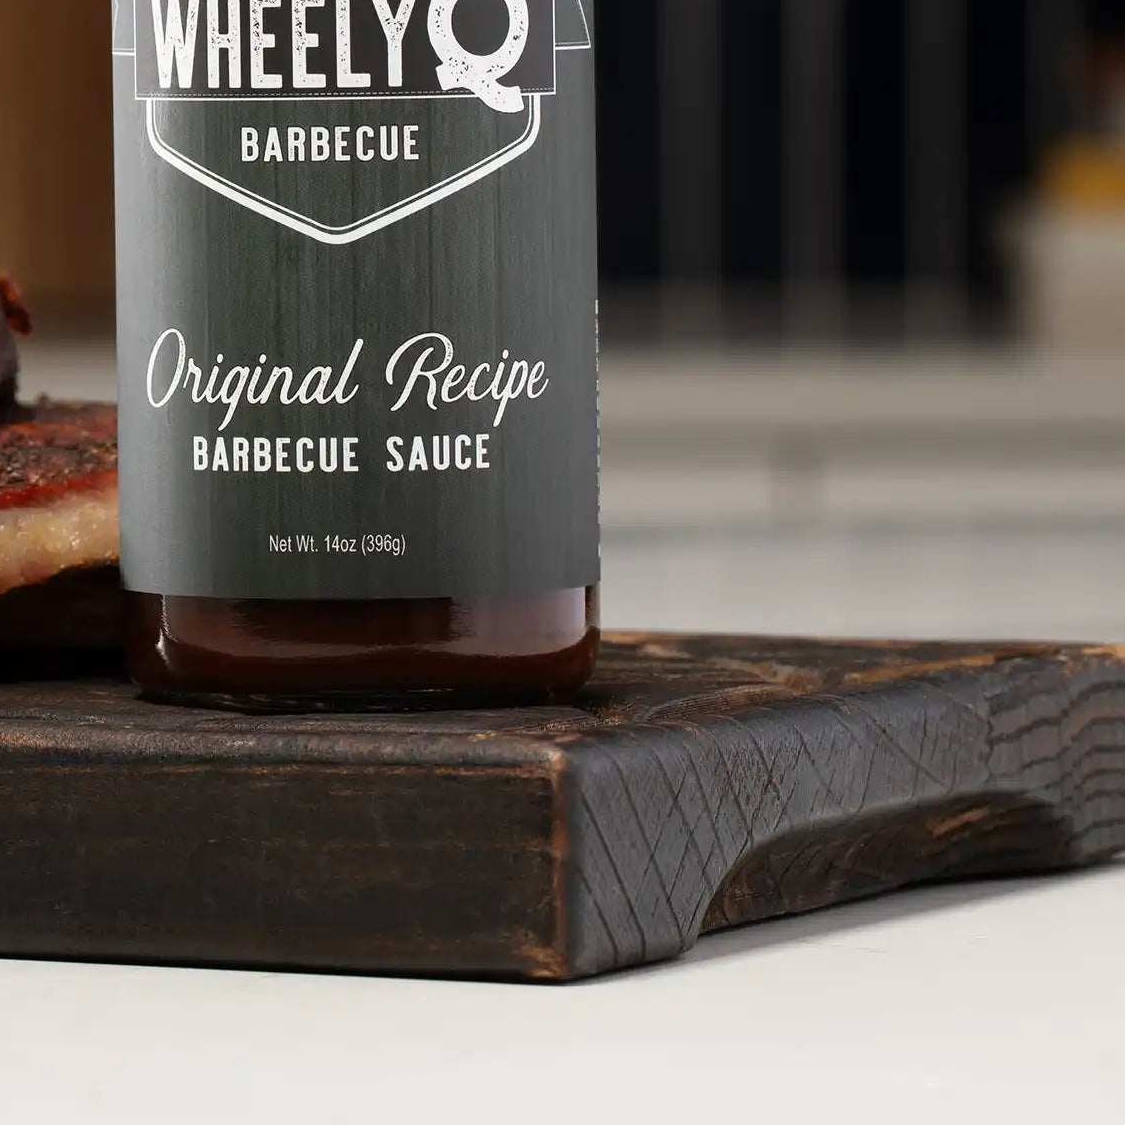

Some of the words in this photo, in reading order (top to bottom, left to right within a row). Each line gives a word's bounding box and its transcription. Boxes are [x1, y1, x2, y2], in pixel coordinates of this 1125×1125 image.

[241, 124, 420, 162] BARBECUE
[147, 328, 364, 432] Original
[386, 332, 549, 427] Recipe
[193, 435, 359, 472] BARBECUE
[386, 433, 490, 471] SAUCE
[269, 534, 292, 553] Net
[295, 534, 319, 553] Wt.
[324, 534, 357, 553] 14oz
[361, 533, 406, 556] (396g)
